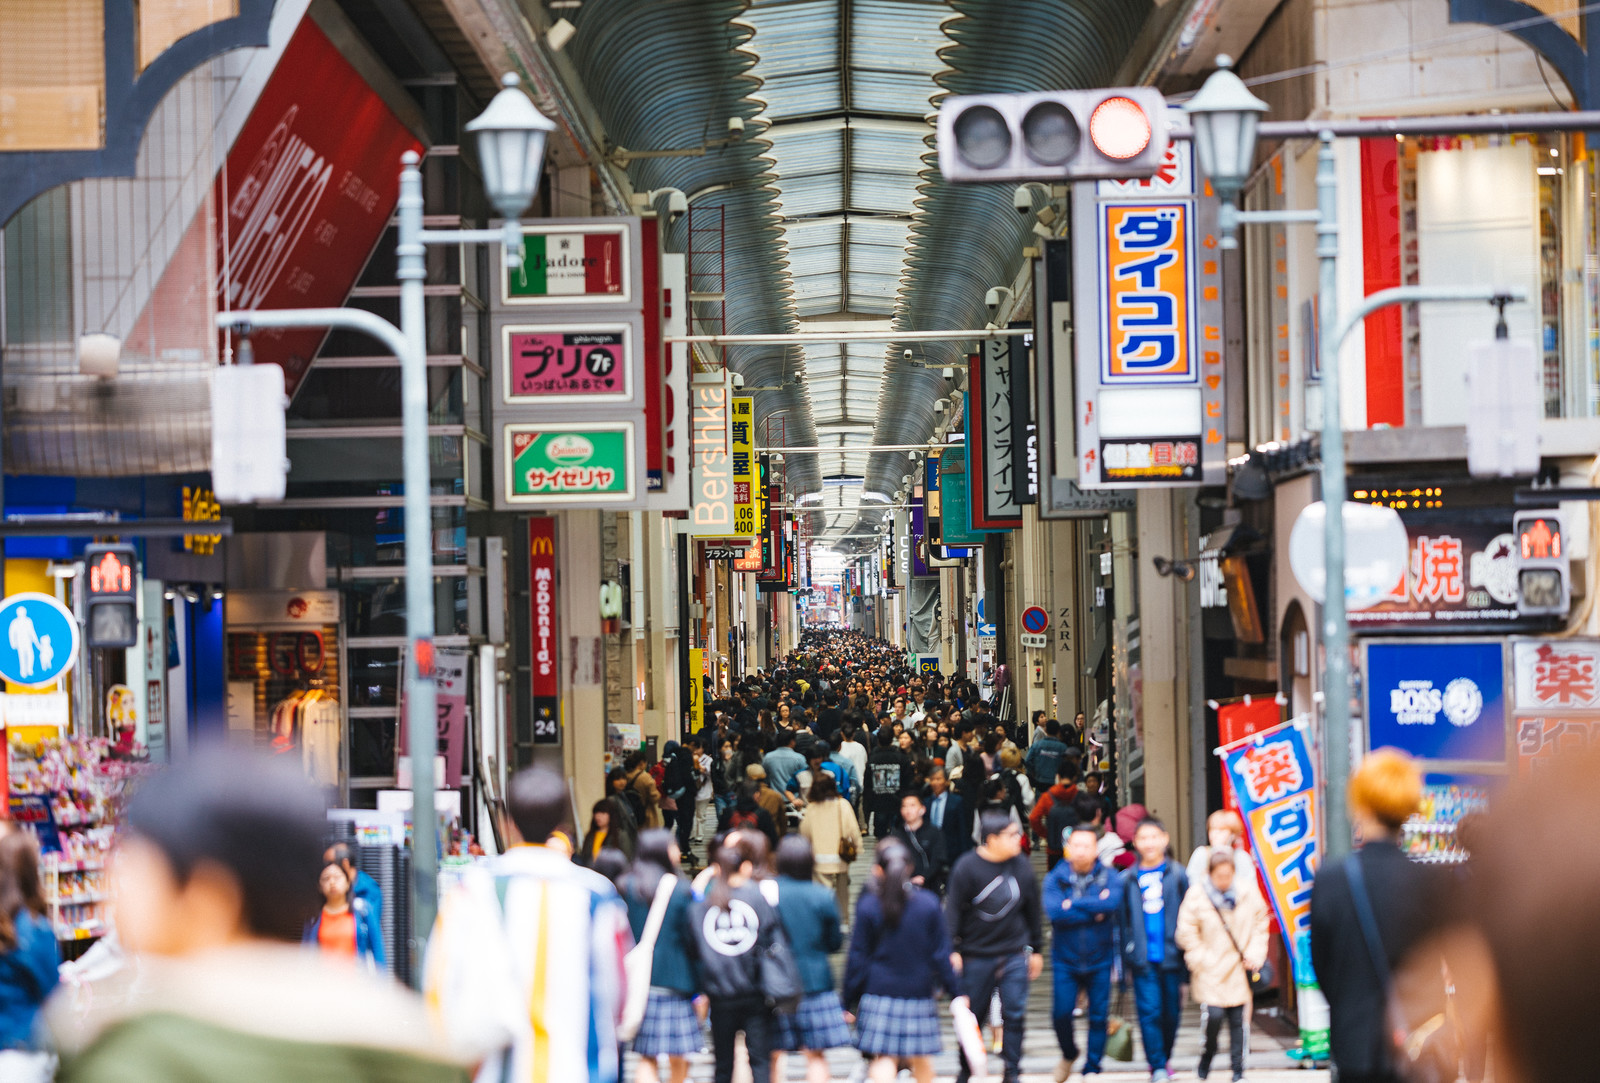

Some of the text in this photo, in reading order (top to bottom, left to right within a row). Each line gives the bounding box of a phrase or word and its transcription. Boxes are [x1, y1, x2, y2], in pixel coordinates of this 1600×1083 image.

[217, 134, 334, 310] WEGO
[1118, 210, 1177, 370] ダイコク
[521, 346, 582, 378] プリ
[590, 354, 611, 373] 7F
[732, 402, 750, 415] 屋
[991, 339, 1013, 510] ジャパンライフ
[694, 388, 728, 525] Bershka
[529, 470, 612, 488] サイゼリヤ
[745, 561, 760, 569] B1F
[535, 567, 552, 675] McDonald's
[1060, 608, 1071, 652] ZARA
[921, 662, 938, 672] GU
[1535, 644, 1594, 703] 薬
[1390, 688, 1442, 713] BOSS
[535, 720, 556, 735] 24
[1248, 745, 1297, 798] 薬
